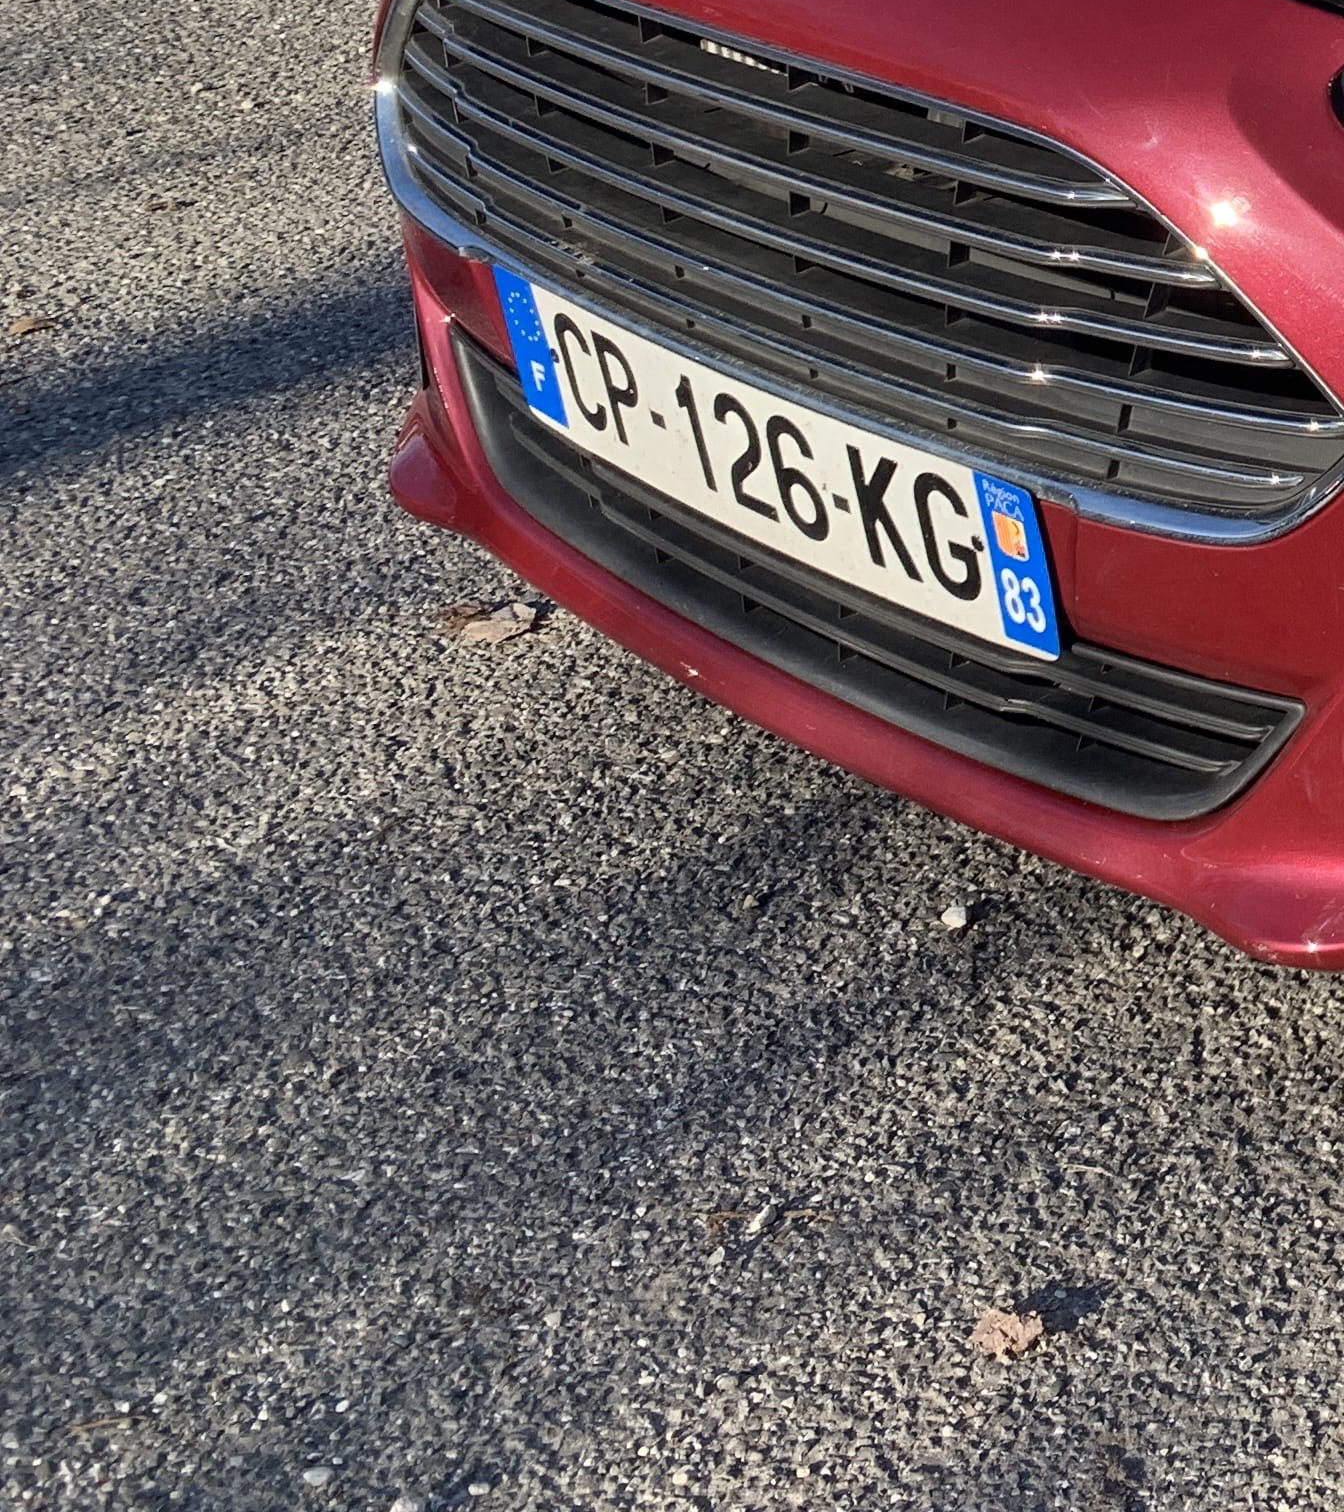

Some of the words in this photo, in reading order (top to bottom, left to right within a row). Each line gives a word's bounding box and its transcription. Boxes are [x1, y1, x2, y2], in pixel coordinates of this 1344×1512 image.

[530, 360, 545, 392] F
[554, 313, 982, 601] CP-126-KG
[985, 493, 1024, 522] PACA
[1001, 568, 1047, 634] 83
